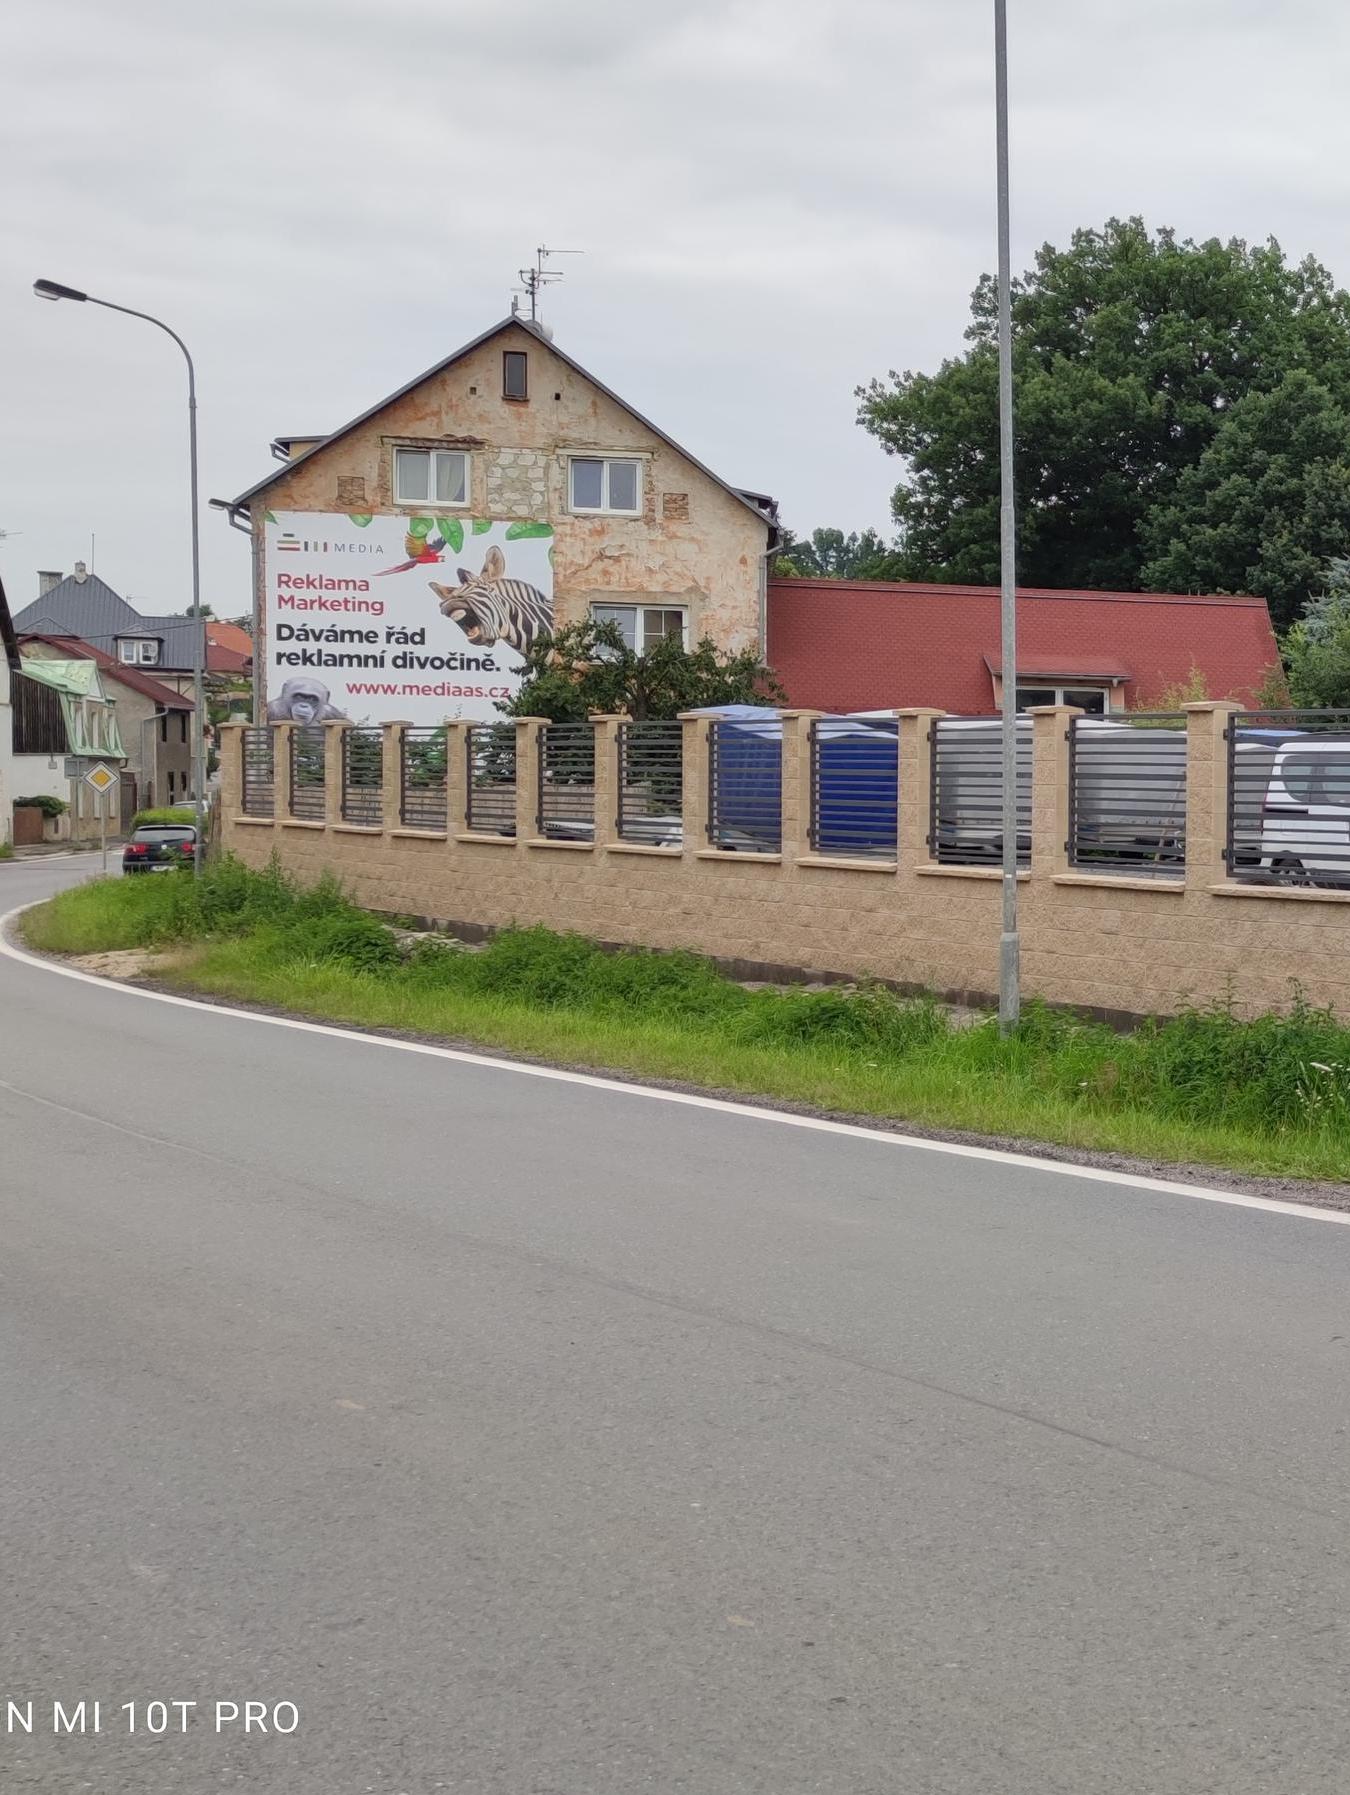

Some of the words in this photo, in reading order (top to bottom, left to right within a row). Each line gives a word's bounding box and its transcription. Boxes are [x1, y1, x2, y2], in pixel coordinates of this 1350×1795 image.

[334, 542, 384, 554] MEDIA
[276, 573, 369, 591] Reklama
[277, 595, 384, 615] Marketing
[276, 623, 378, 644] Dáváme
[385, 625, 425, 645] řád
[276, 649, 385, 669] reklamní
[392, 651, 501, 672] divočině.
[346, 682, 510, 698] www.mediaas.cz
